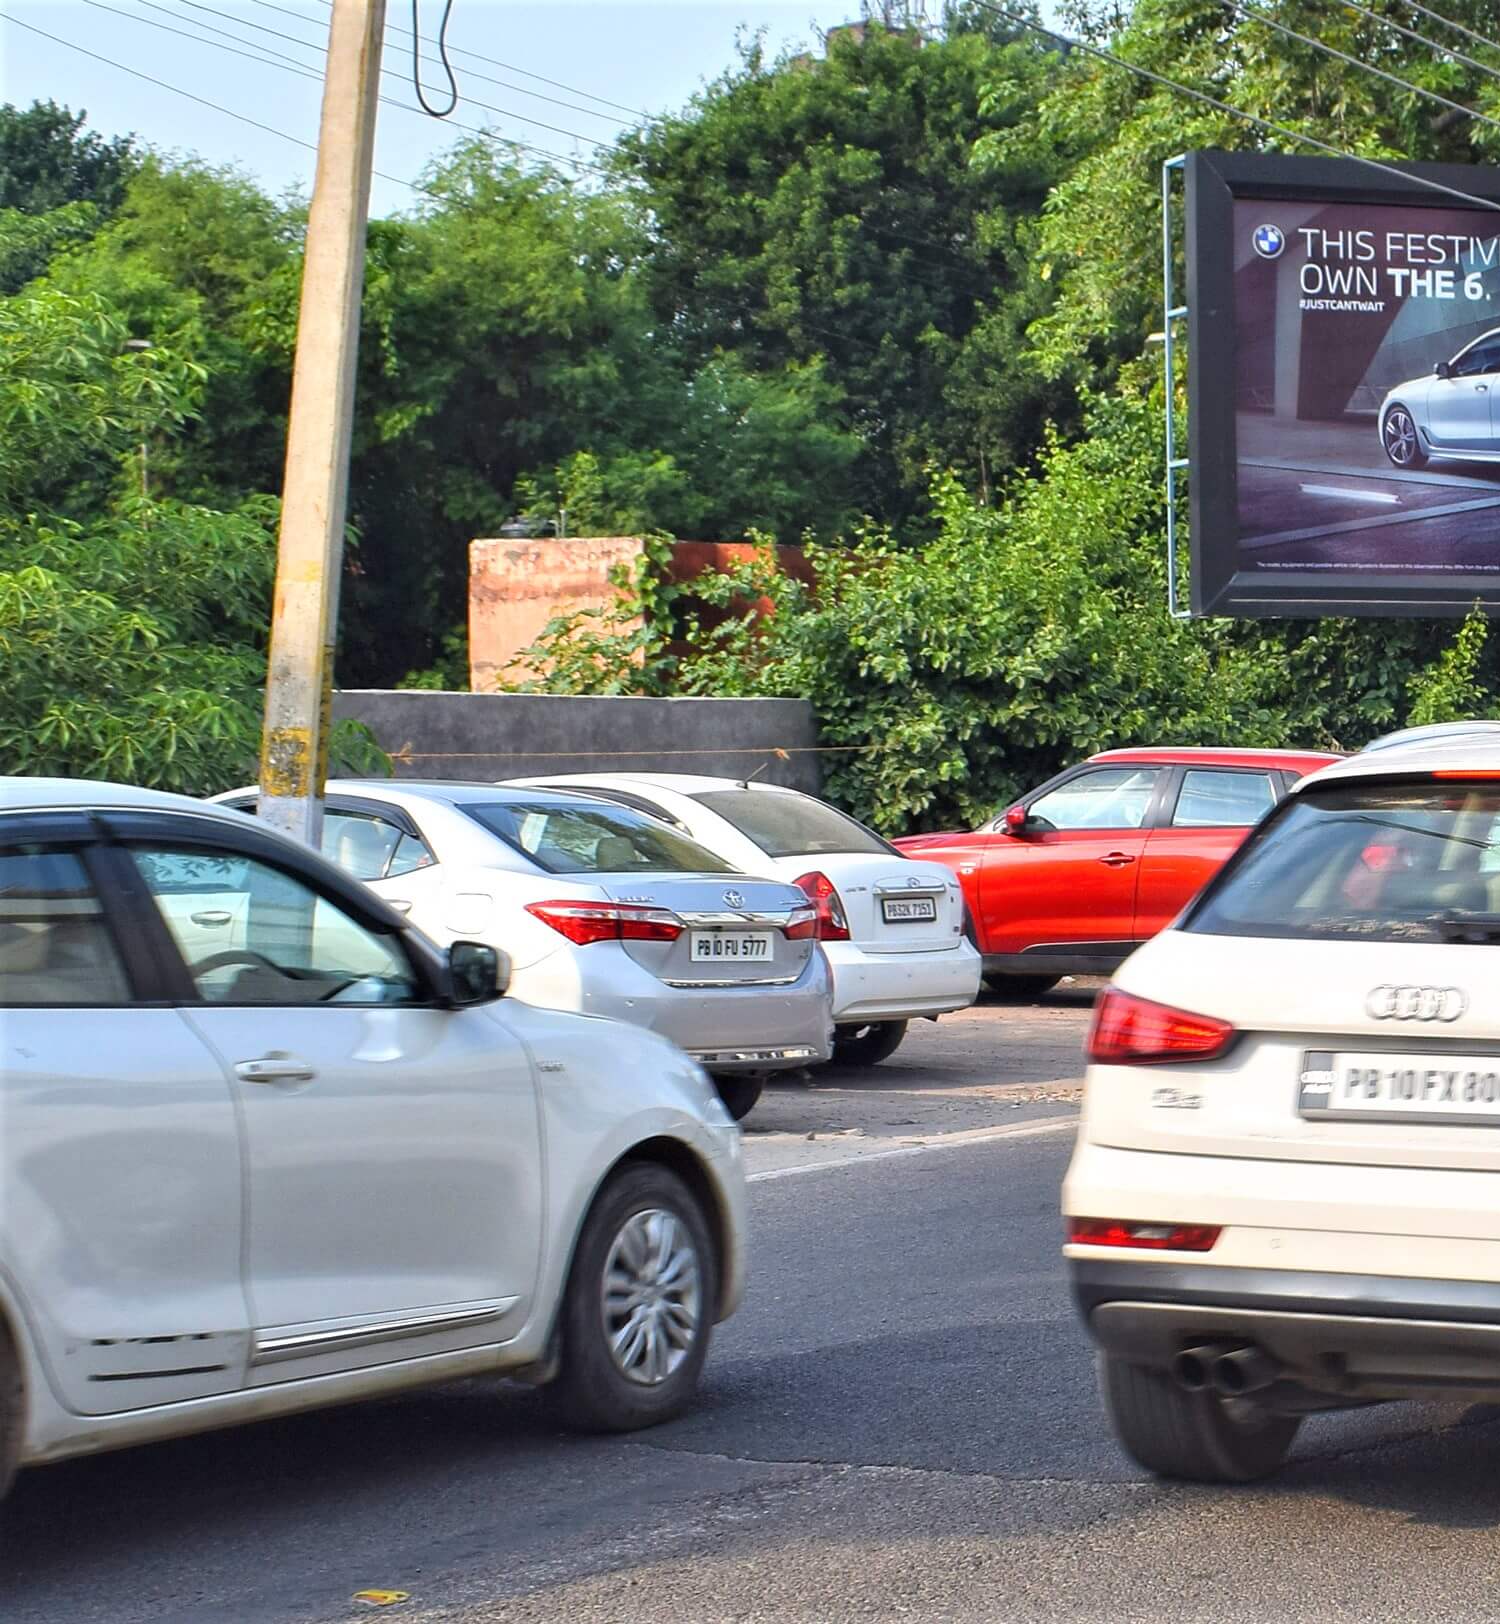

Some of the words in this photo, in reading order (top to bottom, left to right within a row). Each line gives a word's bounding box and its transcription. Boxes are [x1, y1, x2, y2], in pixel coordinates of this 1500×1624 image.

[1298, 228, 1375, 260] THIS
[1300, 263, 1377, 296] OWN
[1386, 267, 1456, 299] THE
[1463, 271, 1490, 301] 6.
[1299, 298, 1385, 312] #JUSTCANTWAIT
[742, 939, 767, 956] 5777
